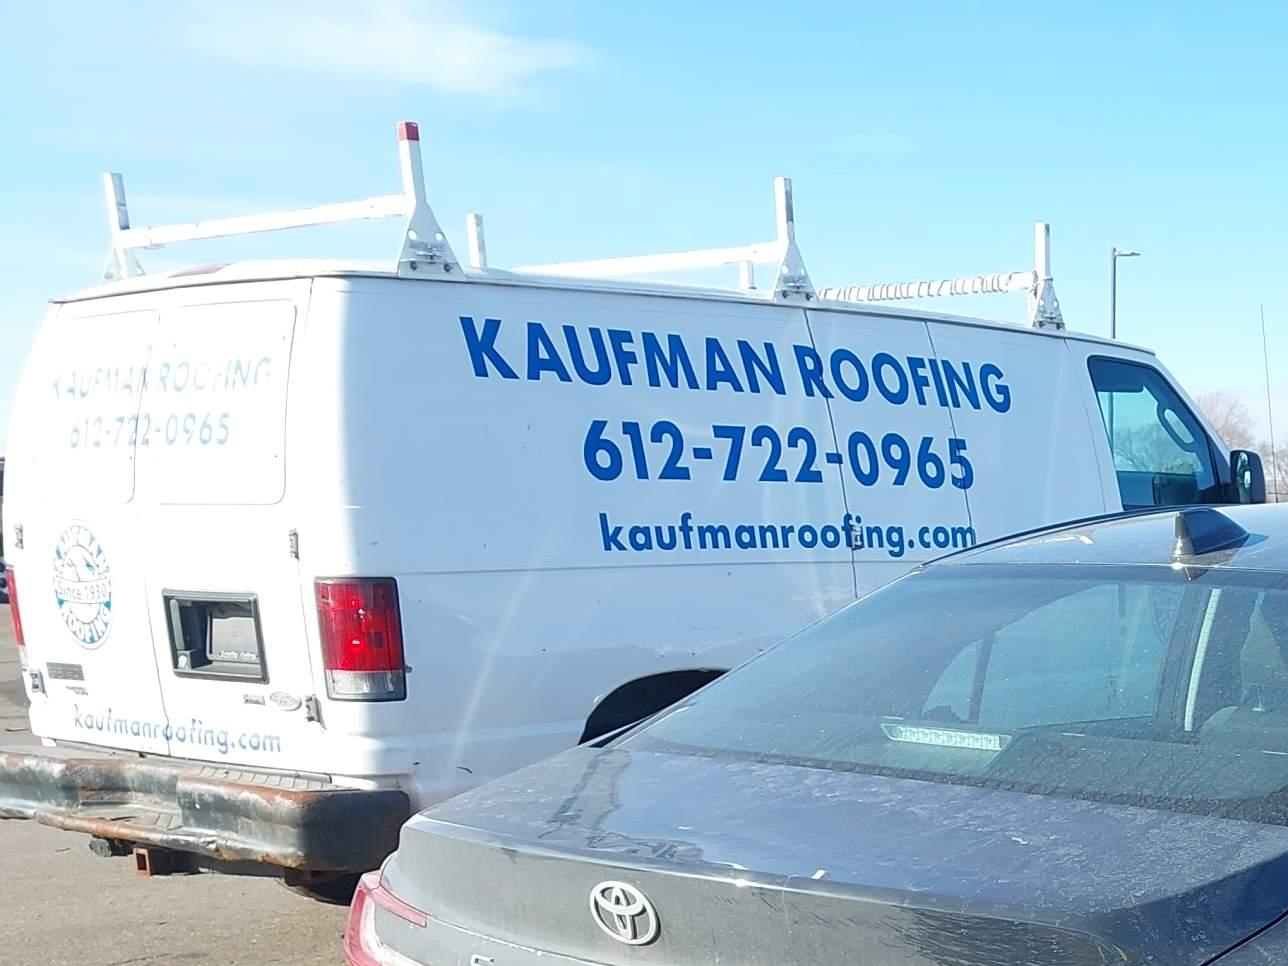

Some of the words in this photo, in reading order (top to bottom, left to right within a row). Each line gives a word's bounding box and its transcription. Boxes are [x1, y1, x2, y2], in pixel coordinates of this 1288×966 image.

[458, 315, 787, 397] KAUFMAN
[792, 343, 1012, 414] ROOFING
[70, 412, 231, 448] 612-722-0965
[583, 420, 975, 490] 612-722-0965
[599, 512, 976, 557] kaufmanroofing.com
[74, 703, 282, 755] kaufmanroofing.com
